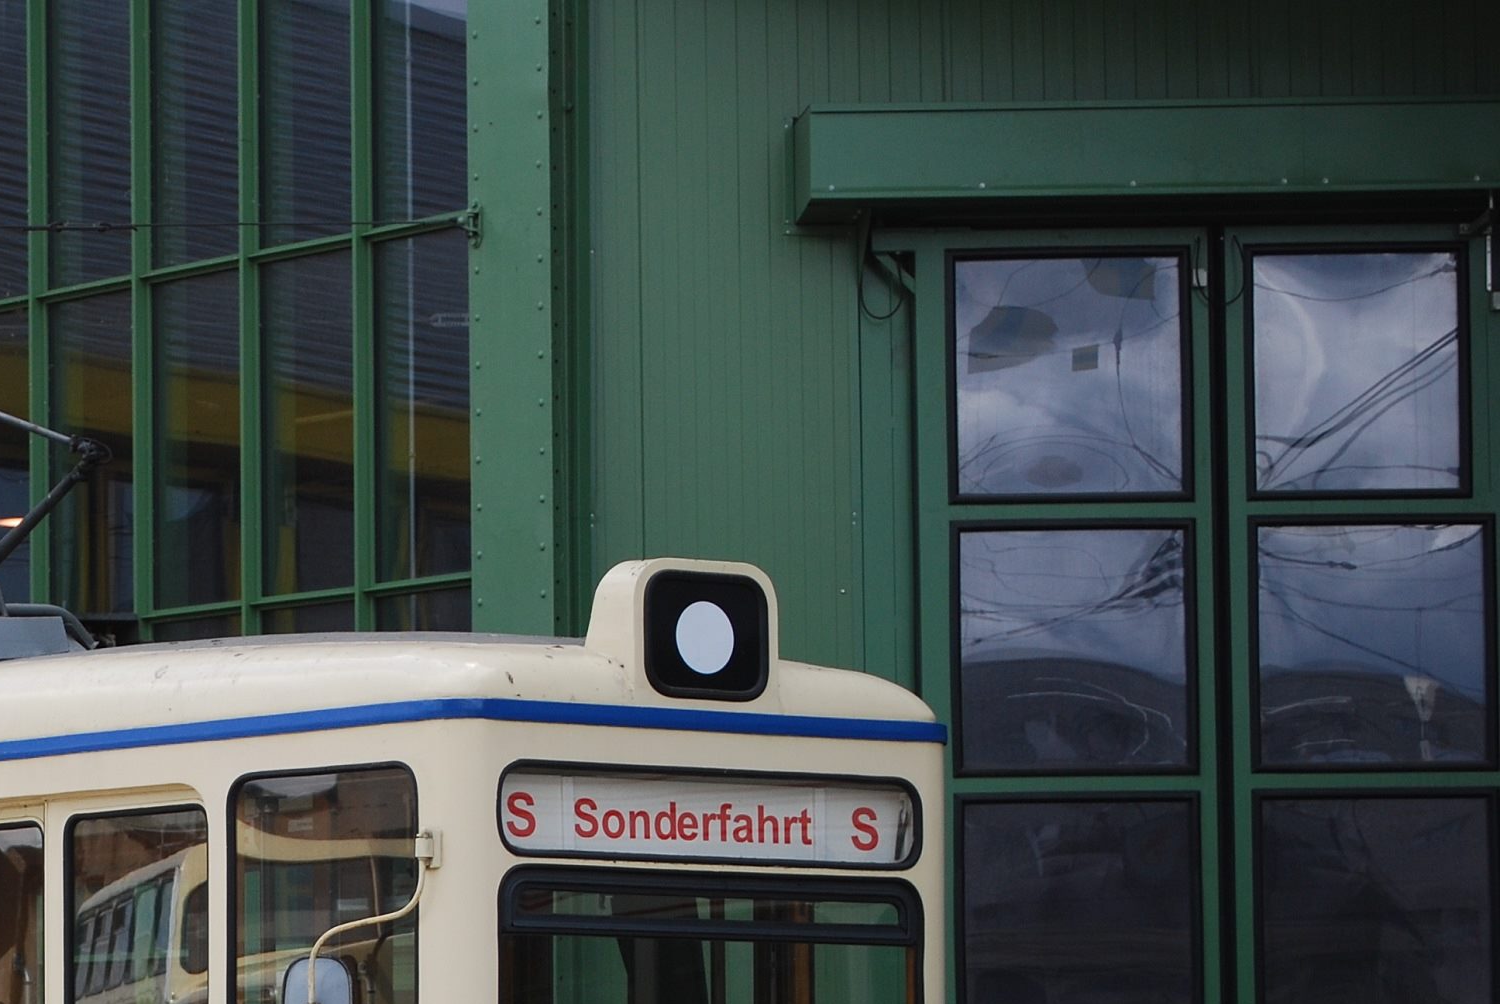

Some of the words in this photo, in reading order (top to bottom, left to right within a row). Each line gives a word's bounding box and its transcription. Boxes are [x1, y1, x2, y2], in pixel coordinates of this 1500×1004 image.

[506, 791, 536, 838] S
[574, 797, 813, 846] Sonderfahrt
[850, 806, 879, 851] S
